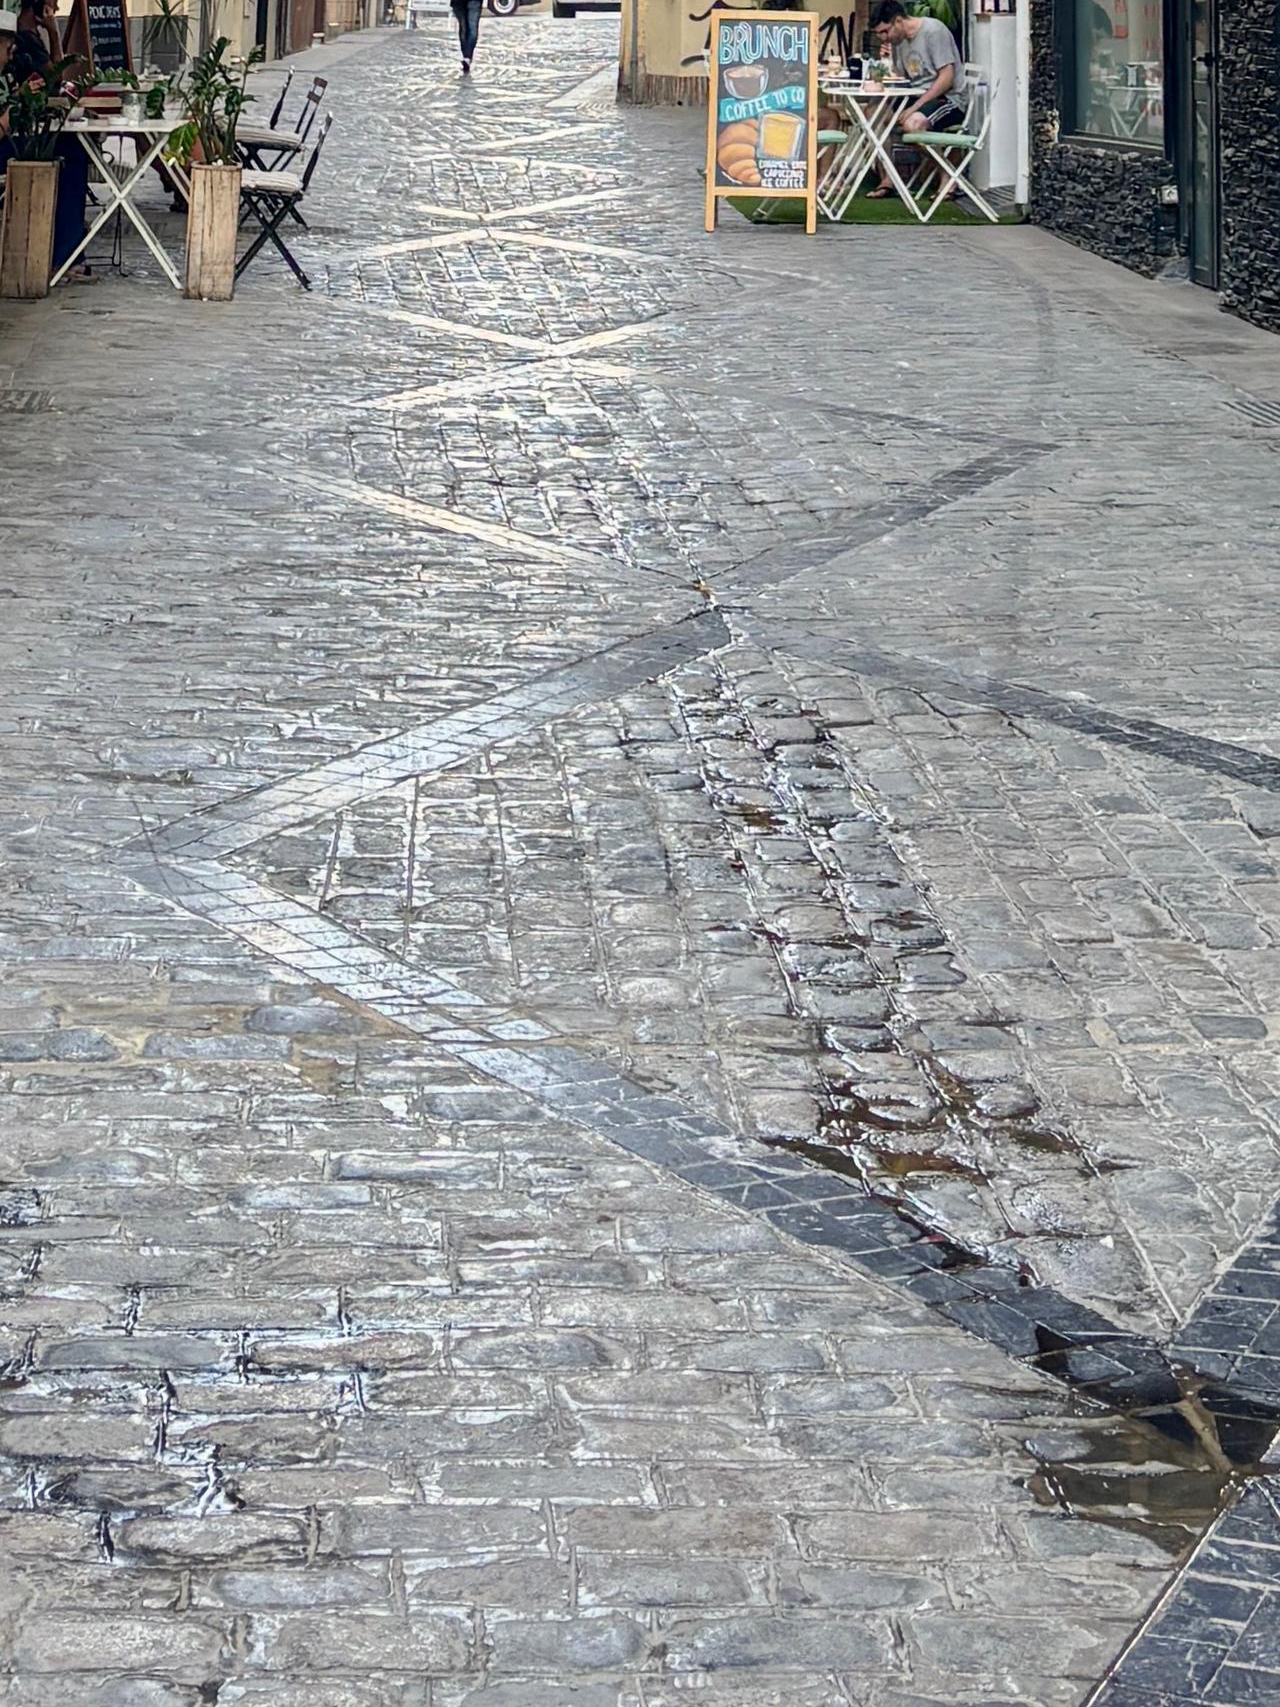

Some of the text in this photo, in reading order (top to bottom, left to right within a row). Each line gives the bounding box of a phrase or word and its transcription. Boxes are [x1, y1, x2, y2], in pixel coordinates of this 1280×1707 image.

[719, 21, 809, 65] BRUNCH
[725, 95, 771, 121] COFFEE
[773, 90, 787, 106] TO
